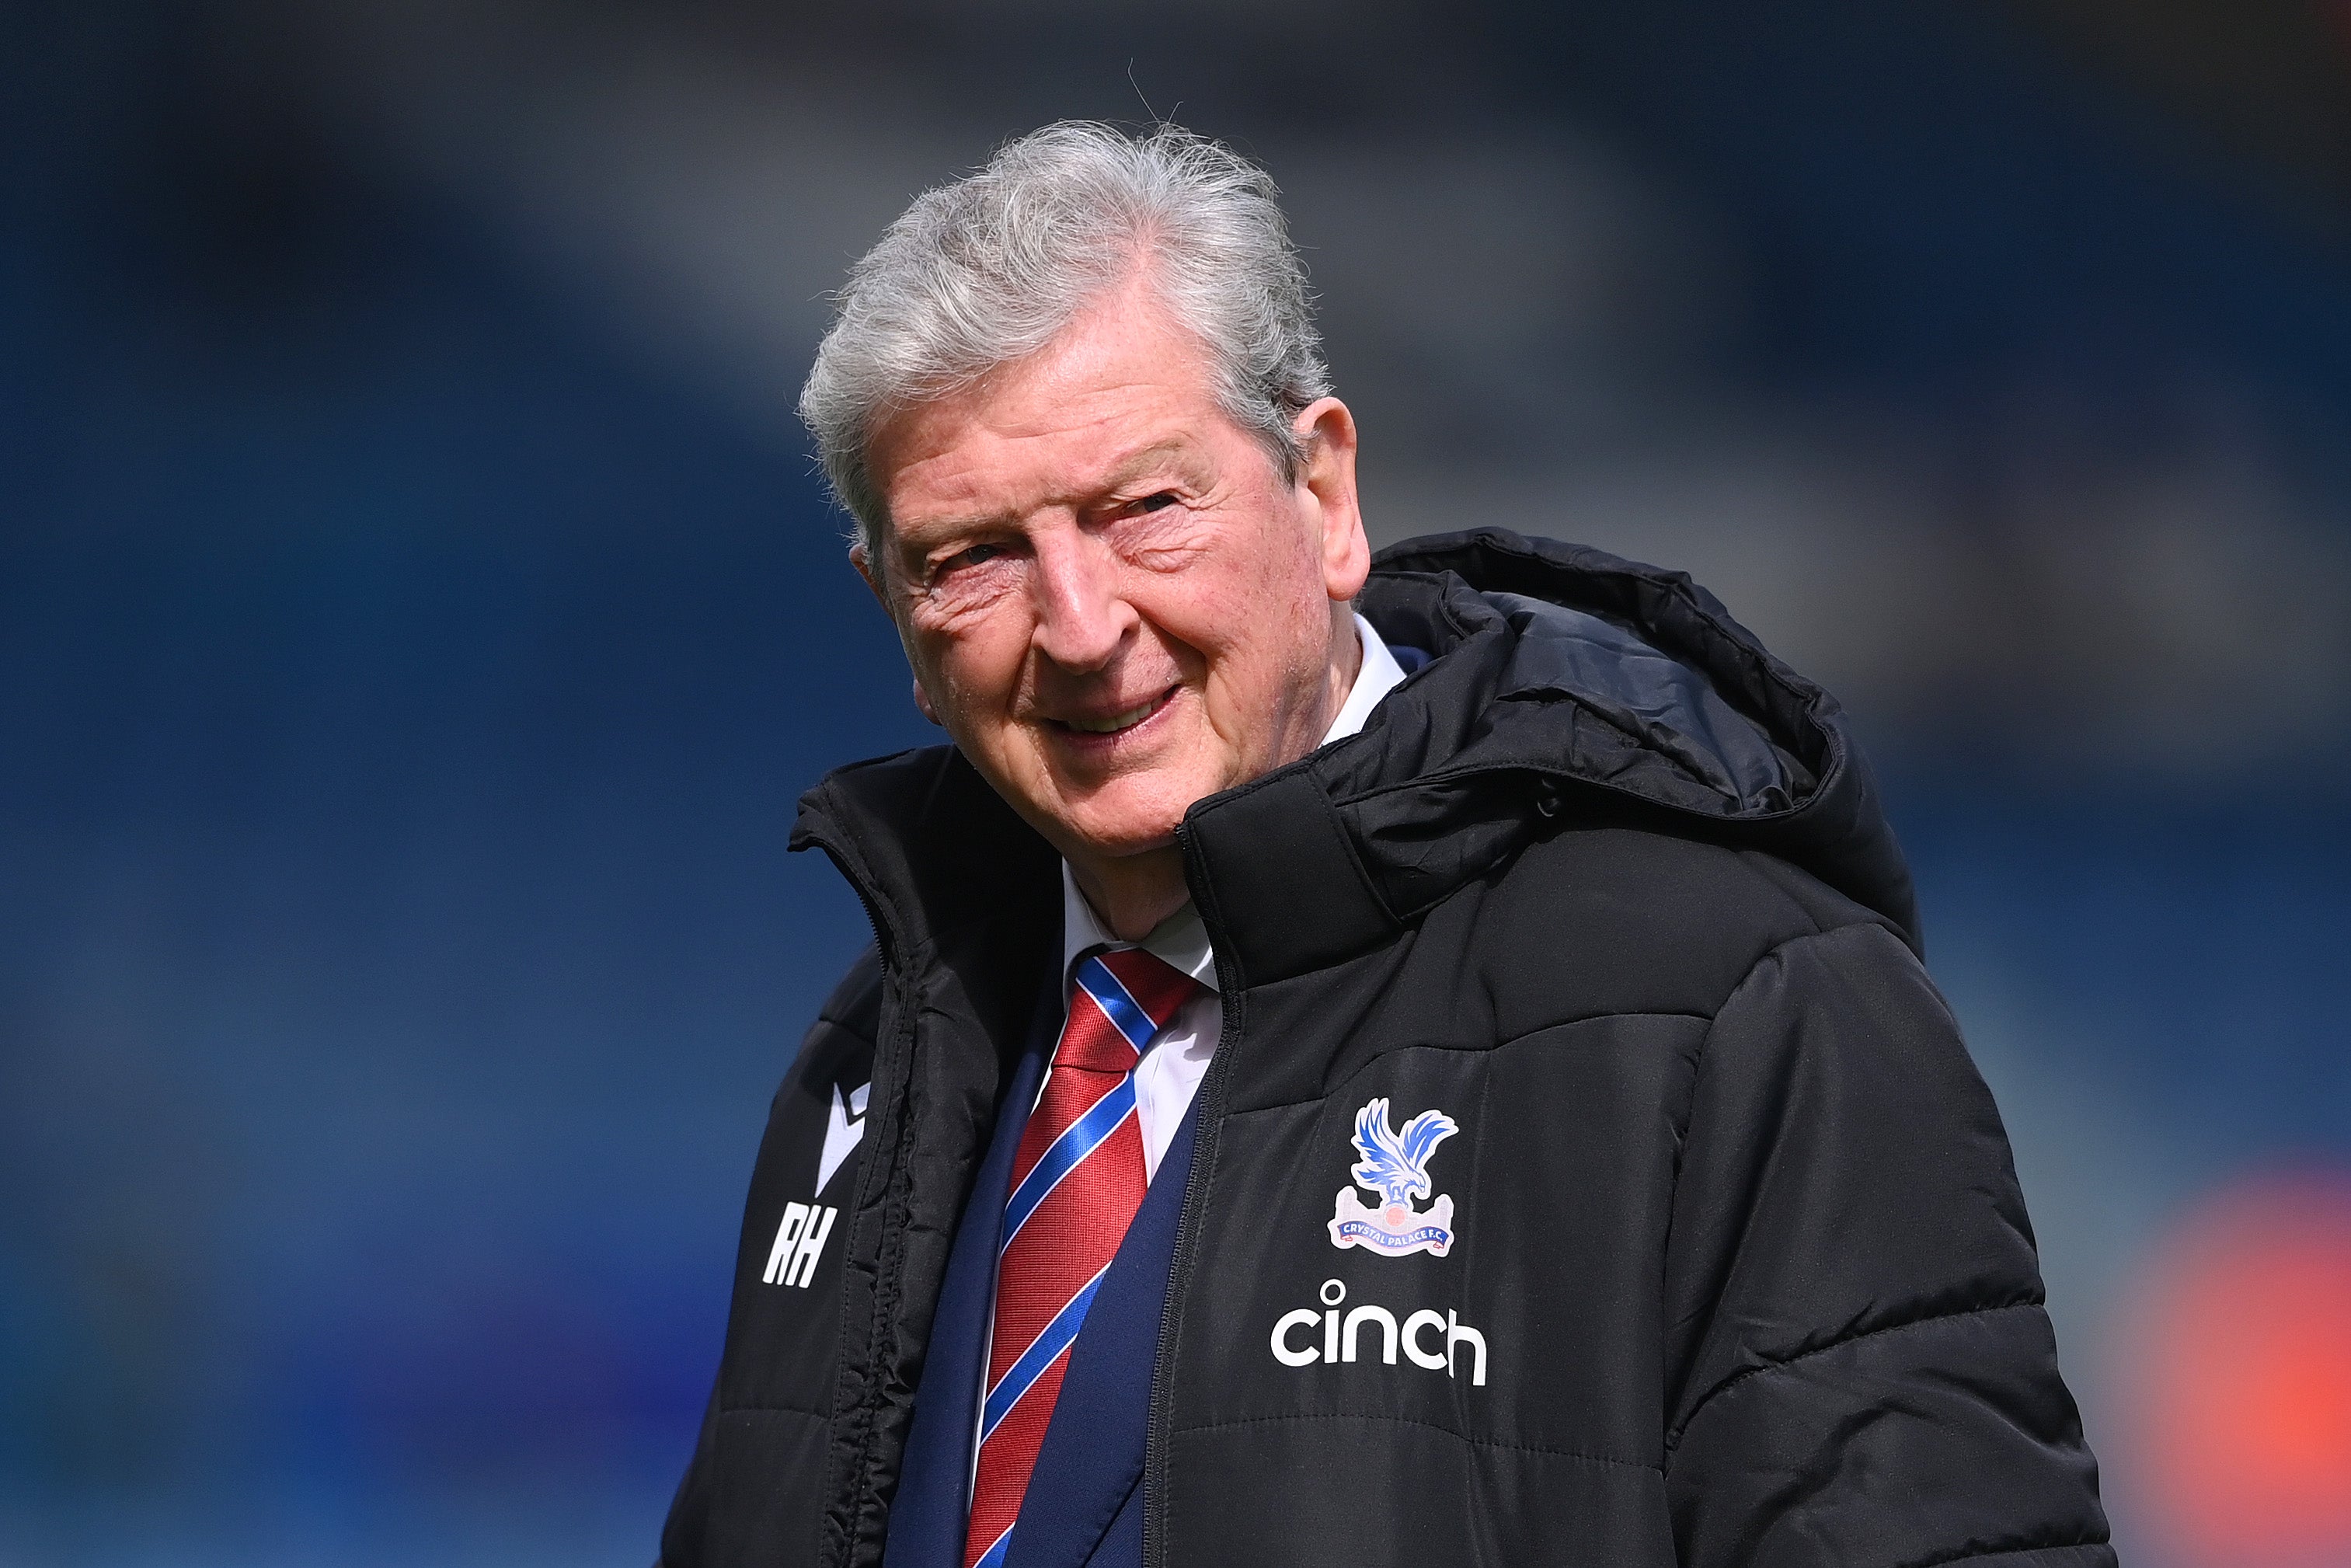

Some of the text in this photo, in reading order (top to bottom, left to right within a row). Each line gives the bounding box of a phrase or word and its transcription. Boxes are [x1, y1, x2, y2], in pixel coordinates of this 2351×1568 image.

[761, 1201, 838, 1288] RH
[1343, 1223, 1443, 1246] CRYSTAL PALACE F.C.
[1270, 1278, 1487, 1386] cinch
